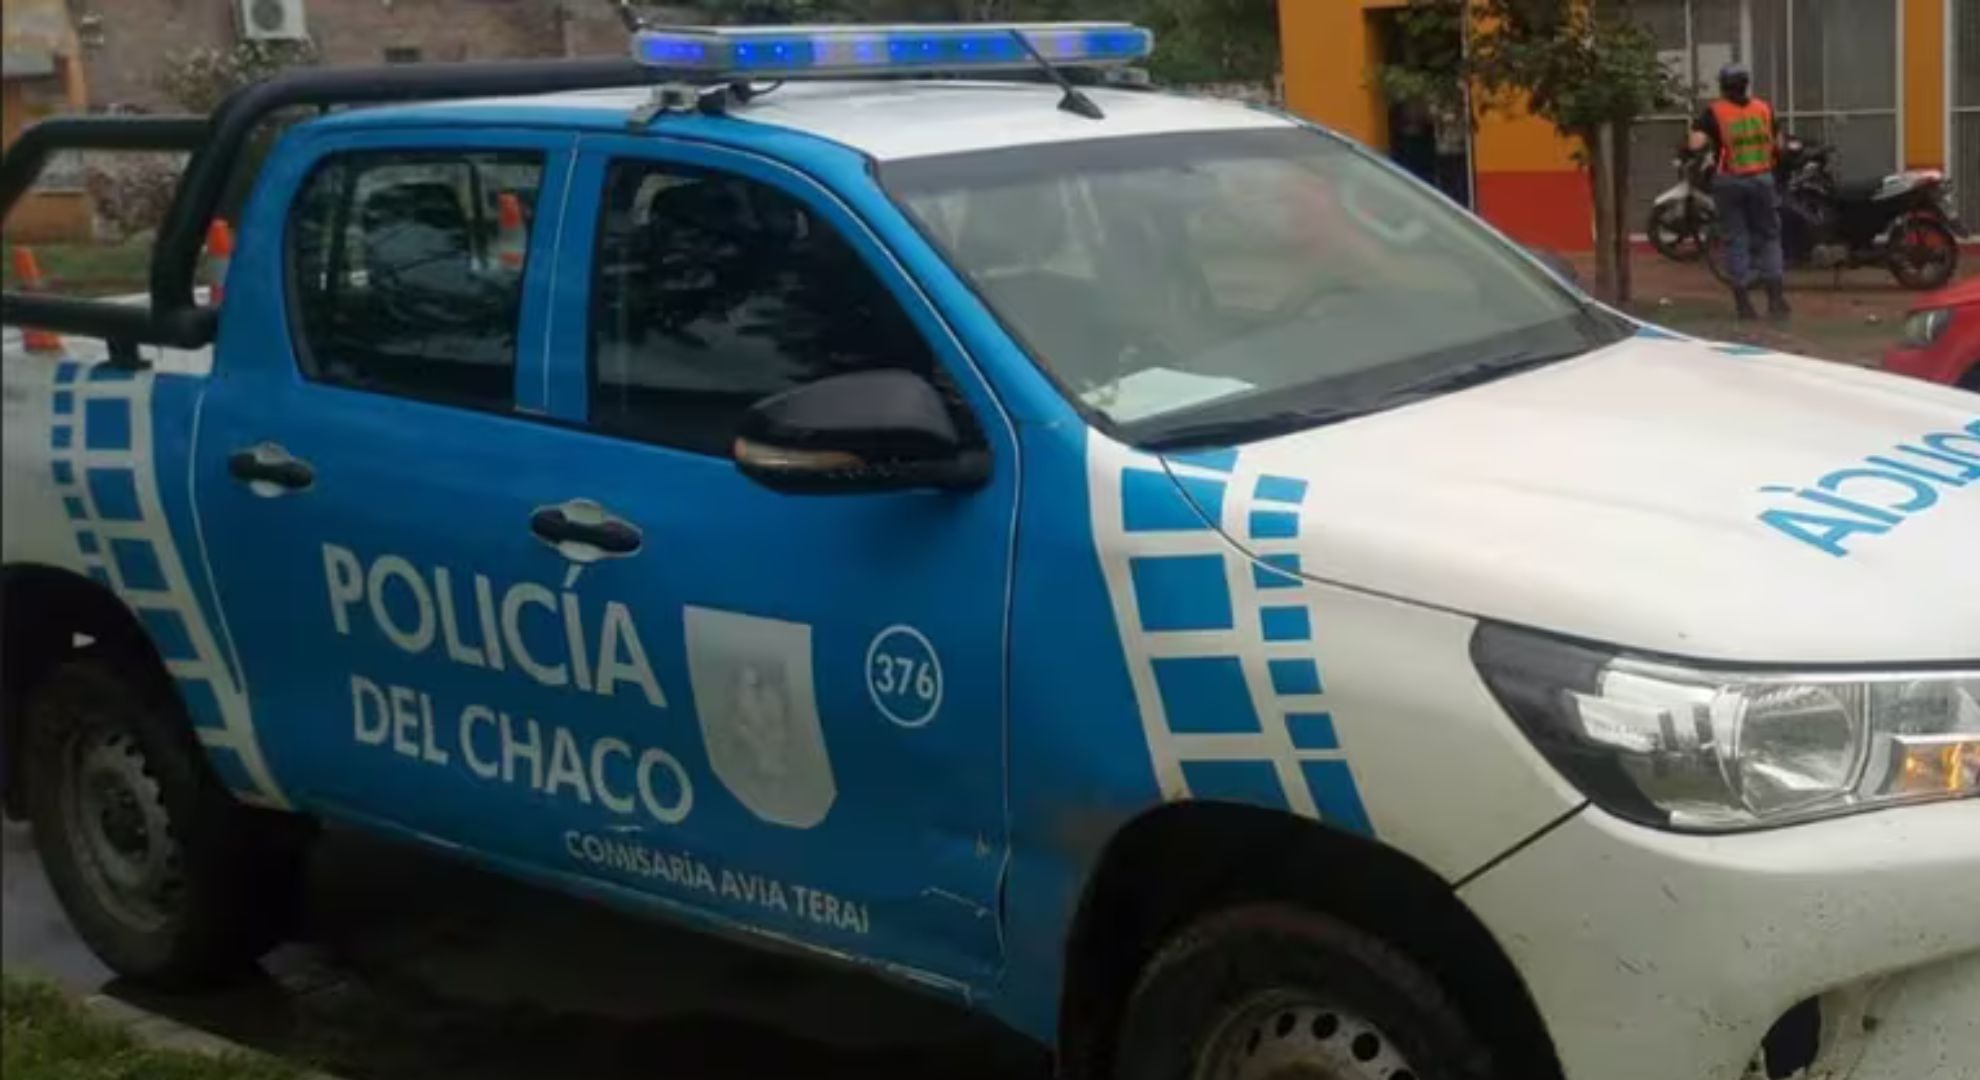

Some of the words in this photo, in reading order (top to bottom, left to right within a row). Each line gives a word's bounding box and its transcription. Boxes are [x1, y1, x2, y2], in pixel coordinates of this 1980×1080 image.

[322, 542, 667, 708] POLICÍA
[875, 654, 935, 699] 376
[351, 673, 448, 765] DEL
[459, 705, 693, 824] CHACO
[720, 869, 789, 911] AVIA
[792, 885, 869, 934] TERAI
